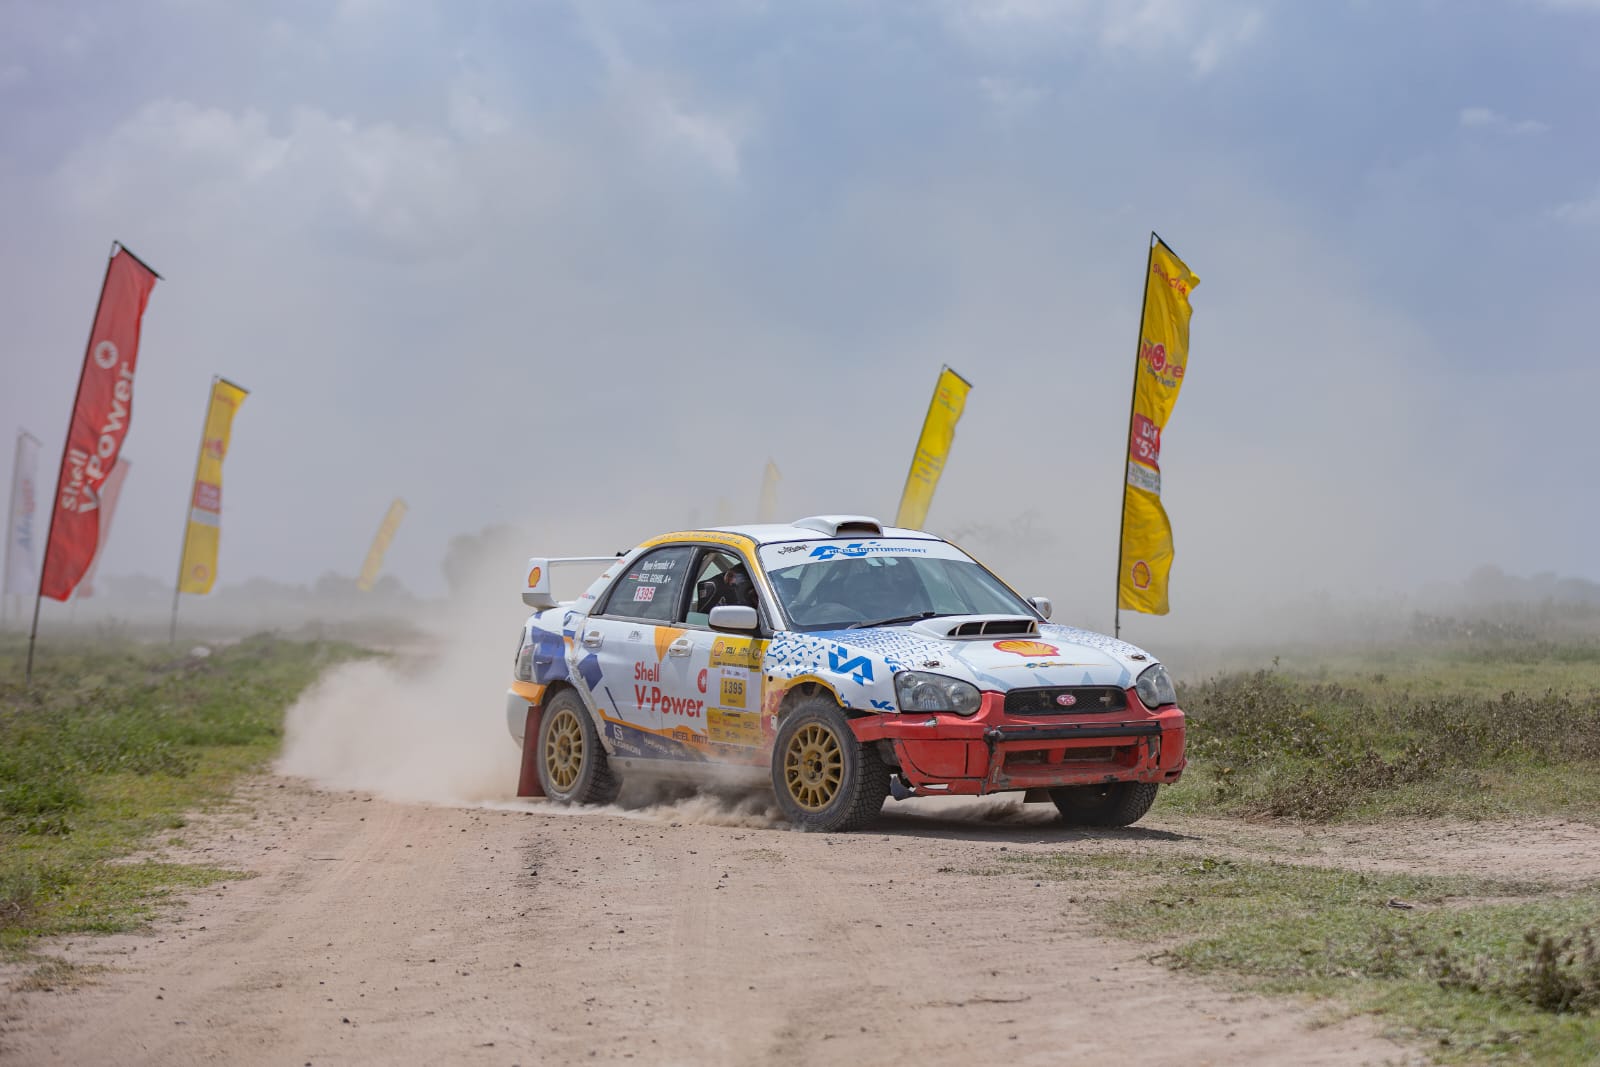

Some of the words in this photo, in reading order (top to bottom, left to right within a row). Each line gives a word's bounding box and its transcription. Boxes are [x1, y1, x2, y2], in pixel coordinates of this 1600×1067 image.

[78, 361, 134, 512] V-Power
[61, 449, 88, 511] Shell
[635, 587, 655, 600] 1395
[634, 661, 660, 682] Shell
[634, 684, 704, 718] V-Power
